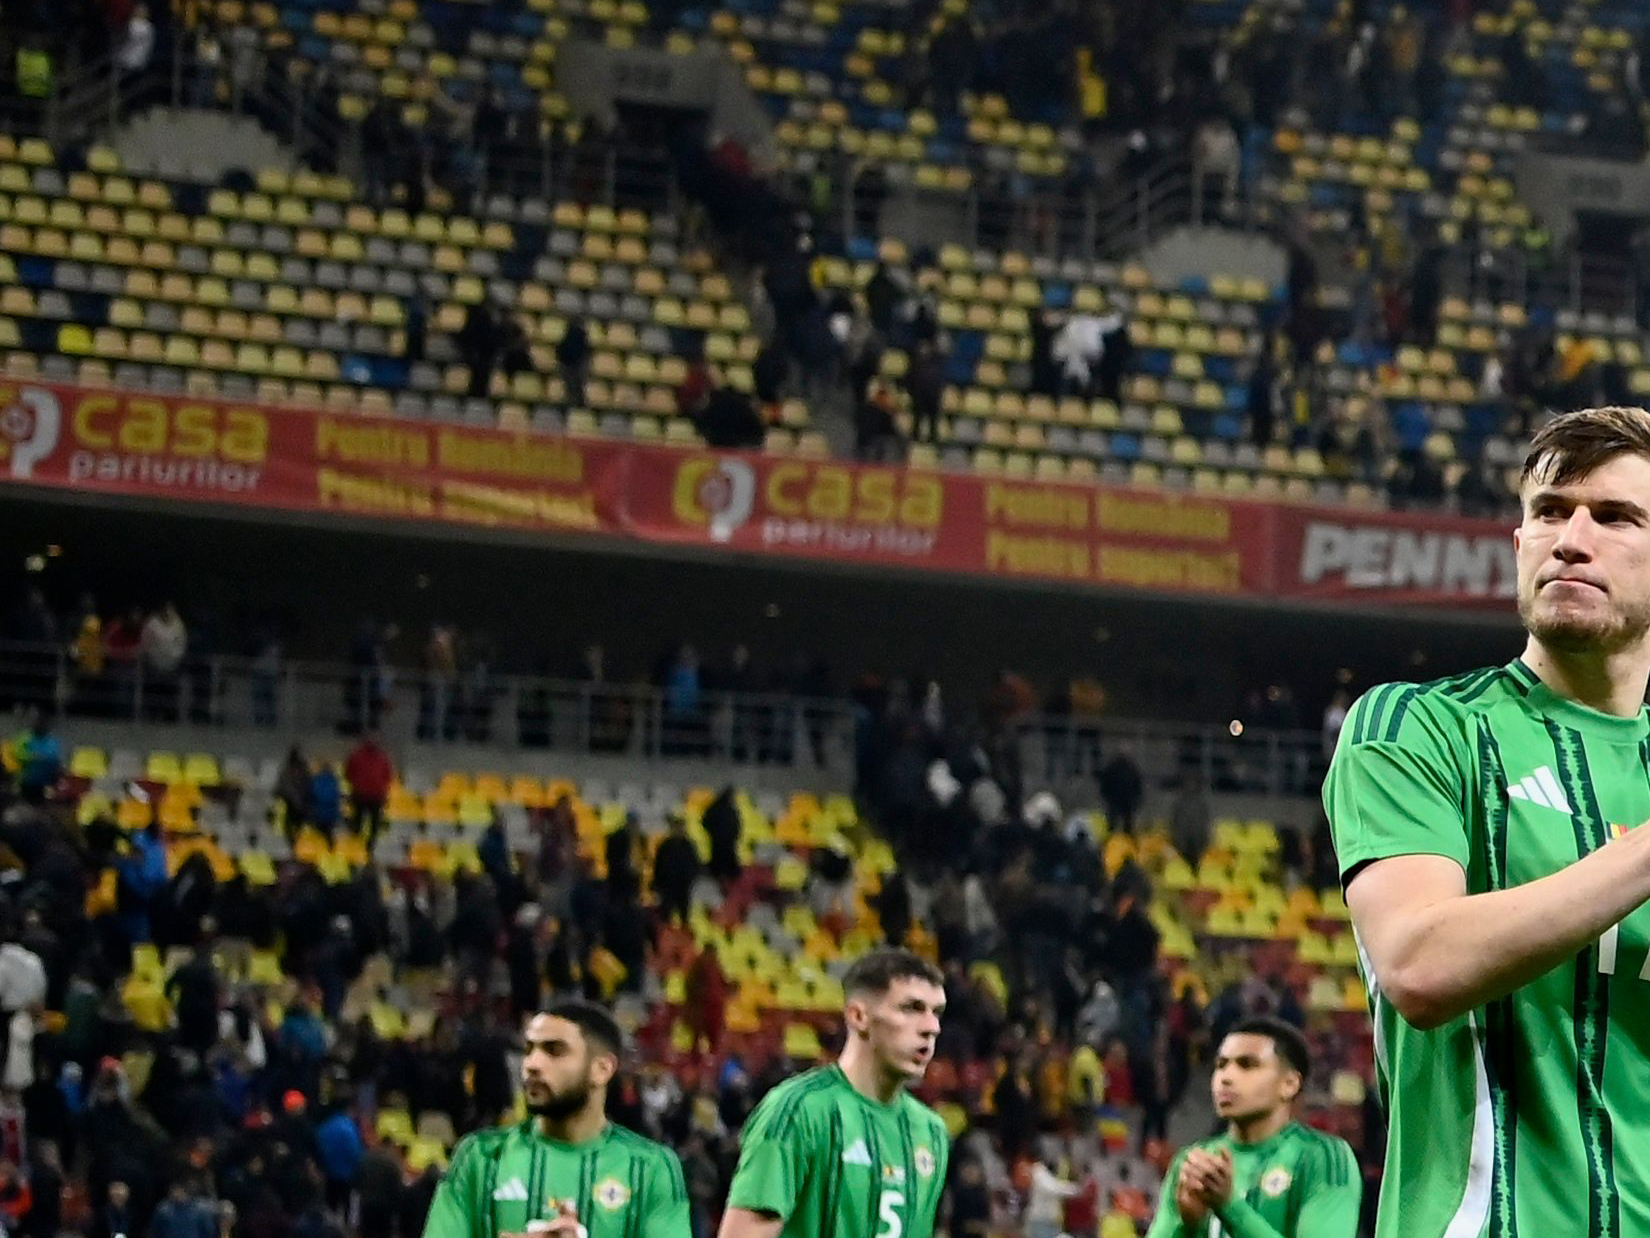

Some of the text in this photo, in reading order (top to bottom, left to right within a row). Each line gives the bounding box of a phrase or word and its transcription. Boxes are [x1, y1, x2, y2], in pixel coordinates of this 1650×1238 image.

[75, 396, 268, 463] casa
[68, 450, 261, 492] pariurilor
[766, 462, 943, 528] casa
